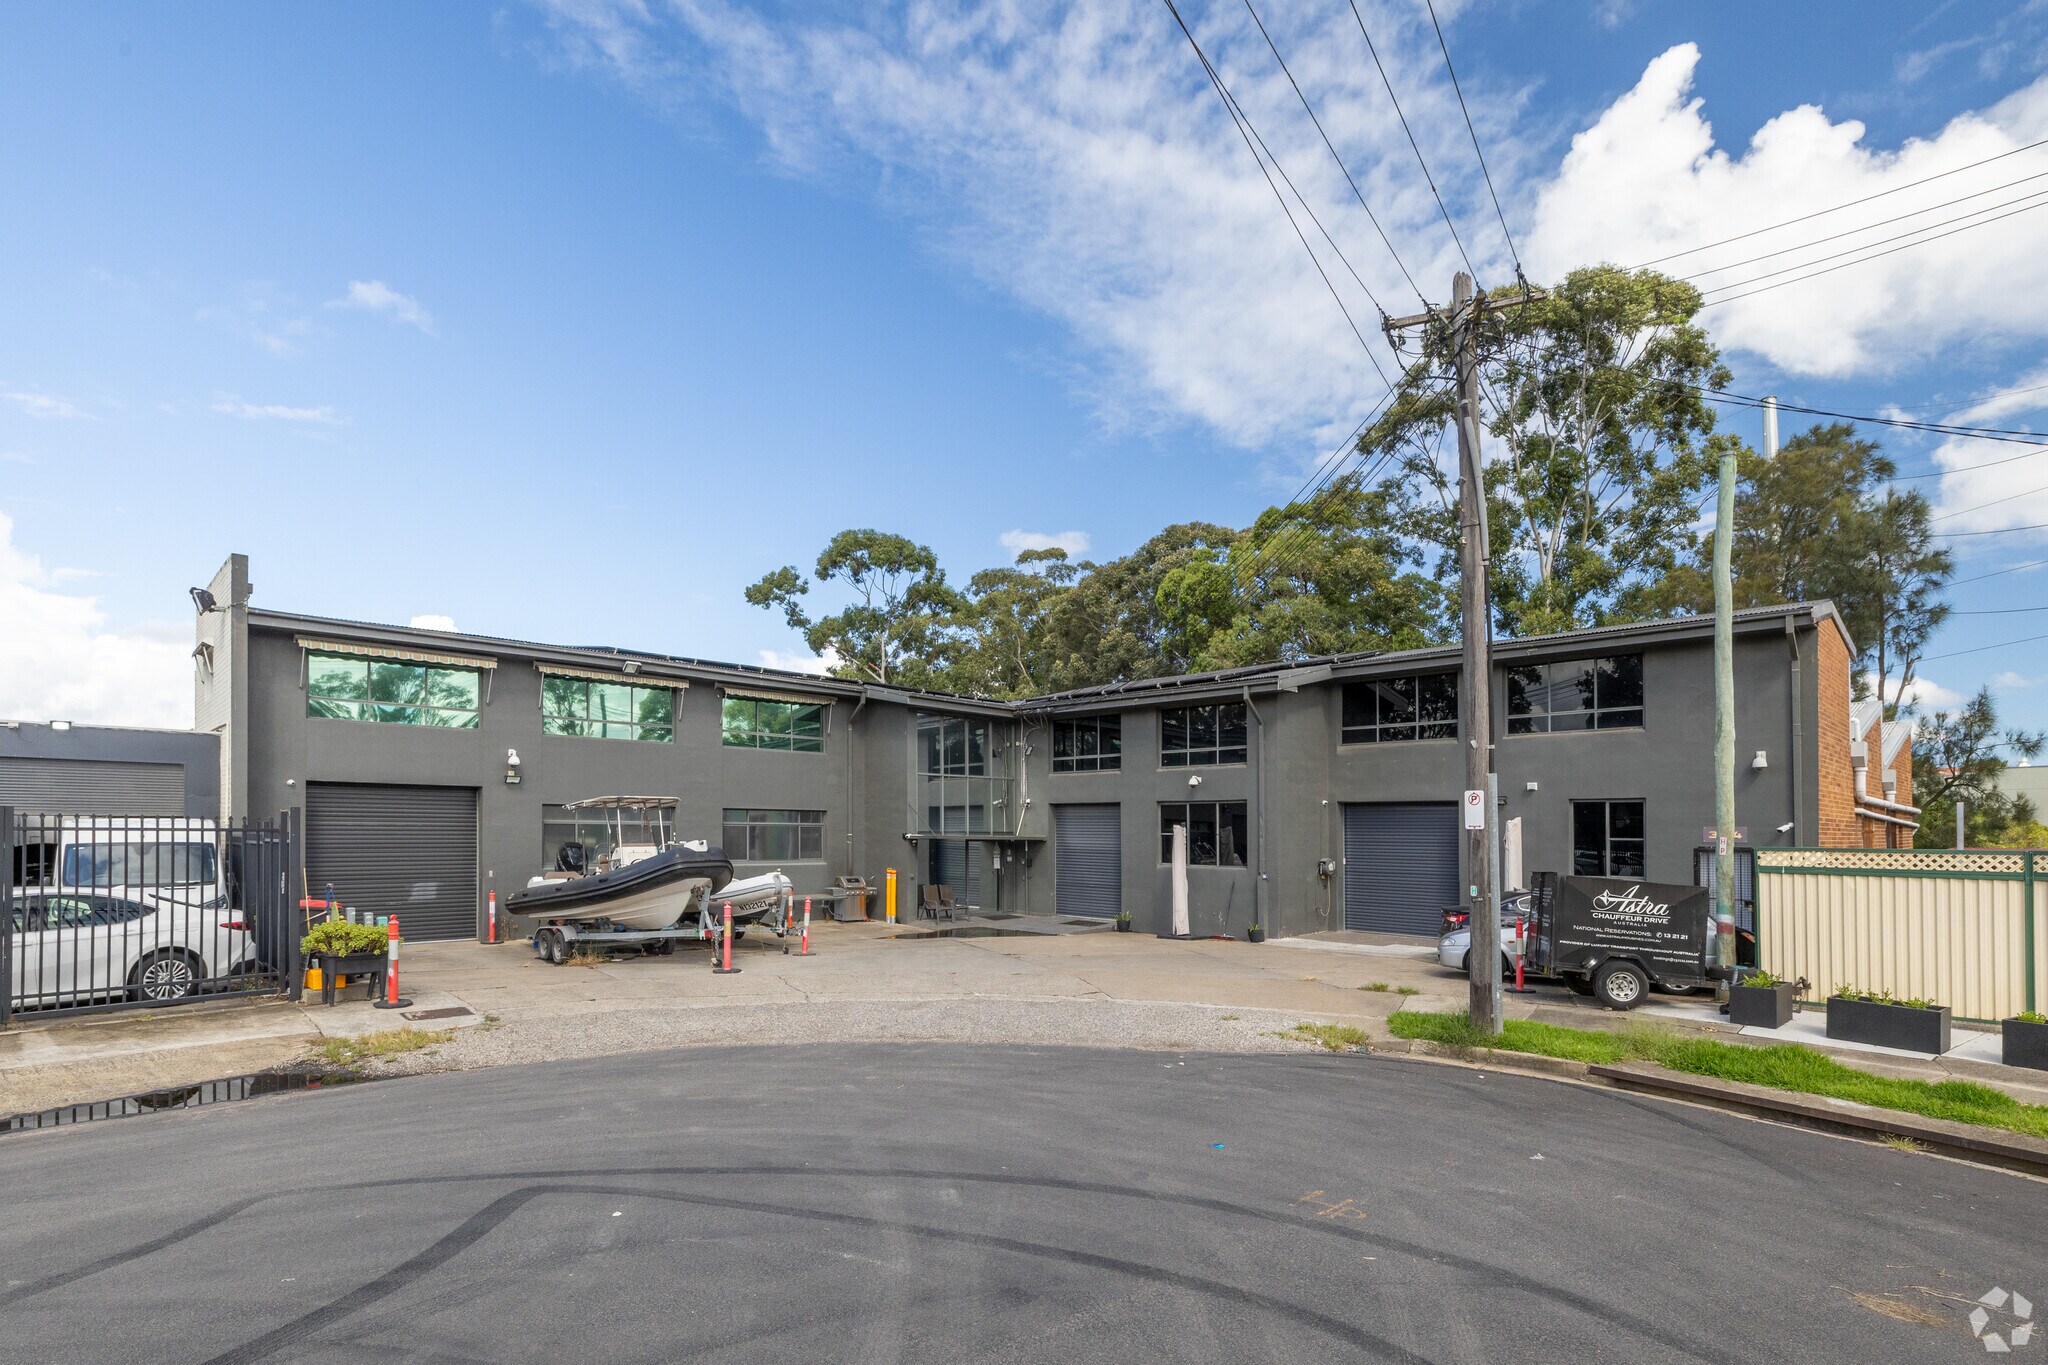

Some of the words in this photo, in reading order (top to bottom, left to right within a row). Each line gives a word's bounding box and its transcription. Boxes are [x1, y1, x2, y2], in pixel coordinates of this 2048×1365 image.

[739, 900, 768, 911] N132121
[1593, 885, 1669, 916] Astra
[1592, 912, 1643, 922] CHAUFFEUR
[1604, 928, 1652, 937] RESERVATIONS:
